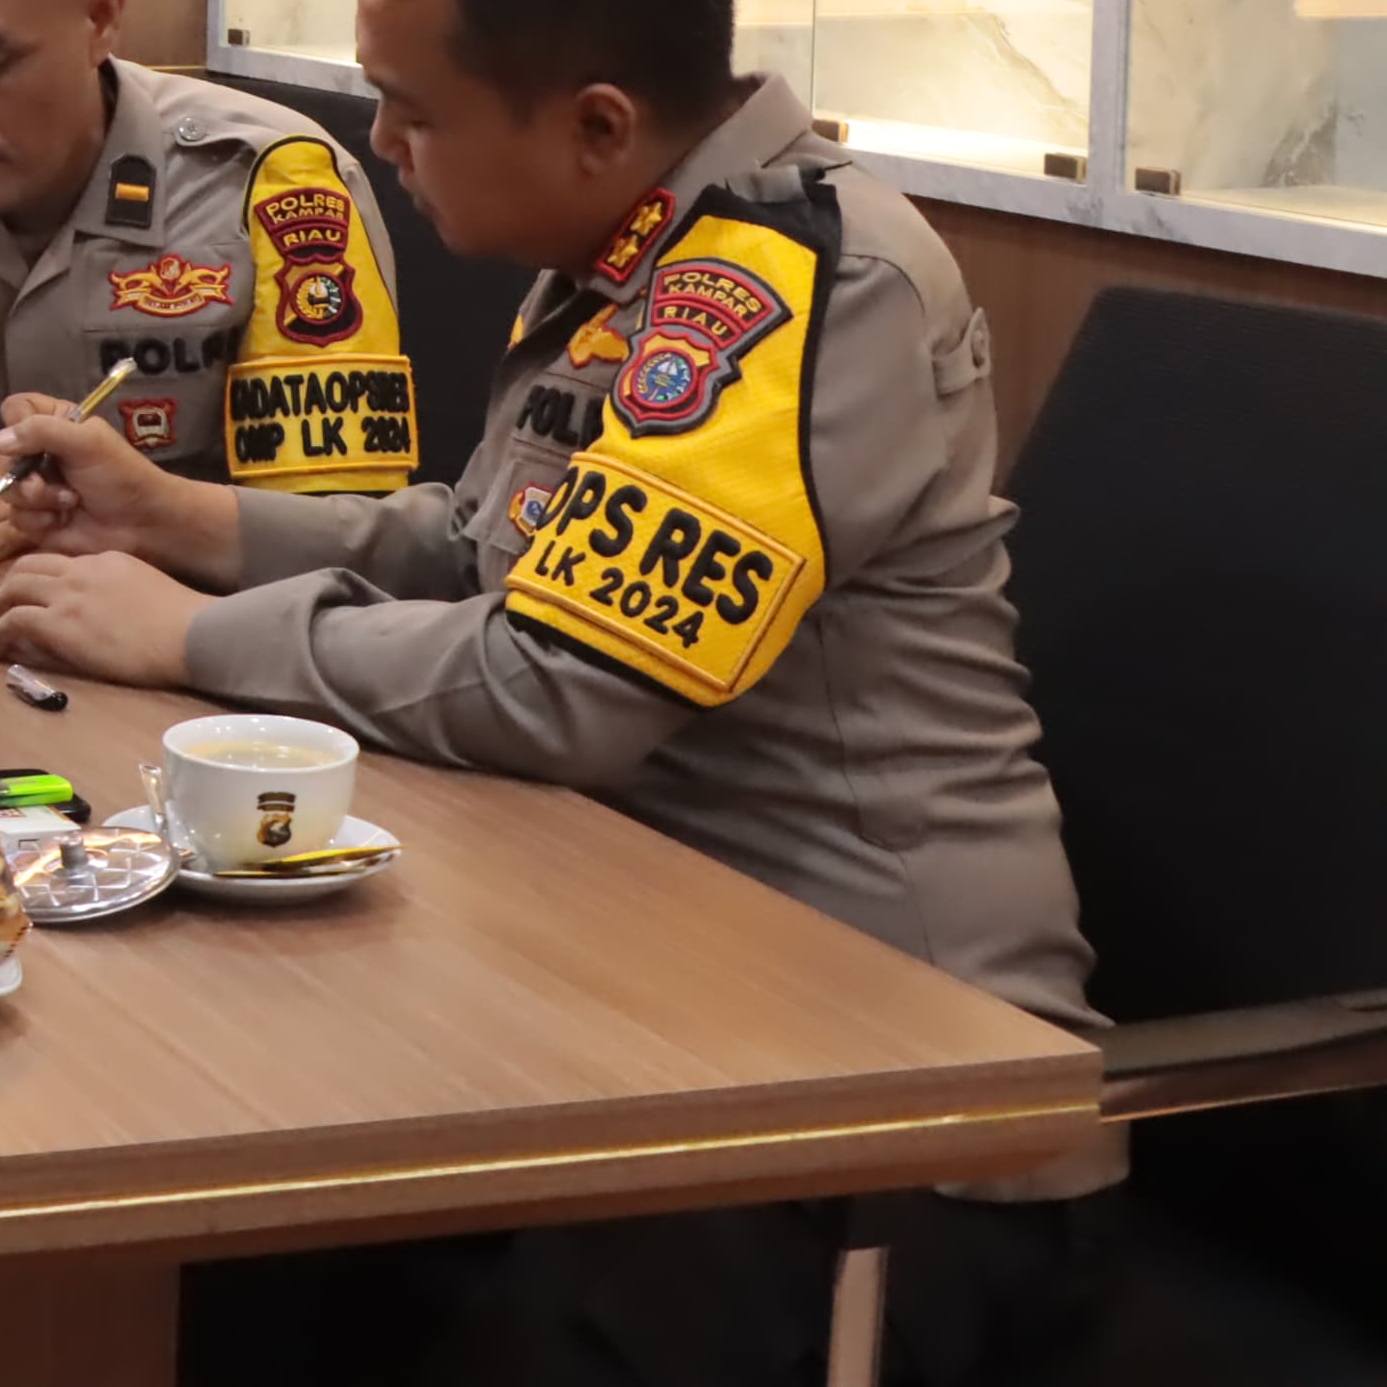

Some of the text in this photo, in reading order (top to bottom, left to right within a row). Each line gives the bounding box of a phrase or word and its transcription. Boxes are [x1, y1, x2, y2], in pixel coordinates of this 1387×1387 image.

[264, 193, 345, 217] POLRES
[272, 207, 345, 225] KAMPAR
[282, 228, 342, 247] RIAU
[663, 271, 762, 313] POLRES
[667, 283, 748, 319] KAMPAR
[663, 305, 728, 336] RIAU
[301, 416, 348, 457] LK
[360, 415, 412, 454] 2024
[638, 506, 774, 625] RES
[534, 539, 705, 649] LK 2024
